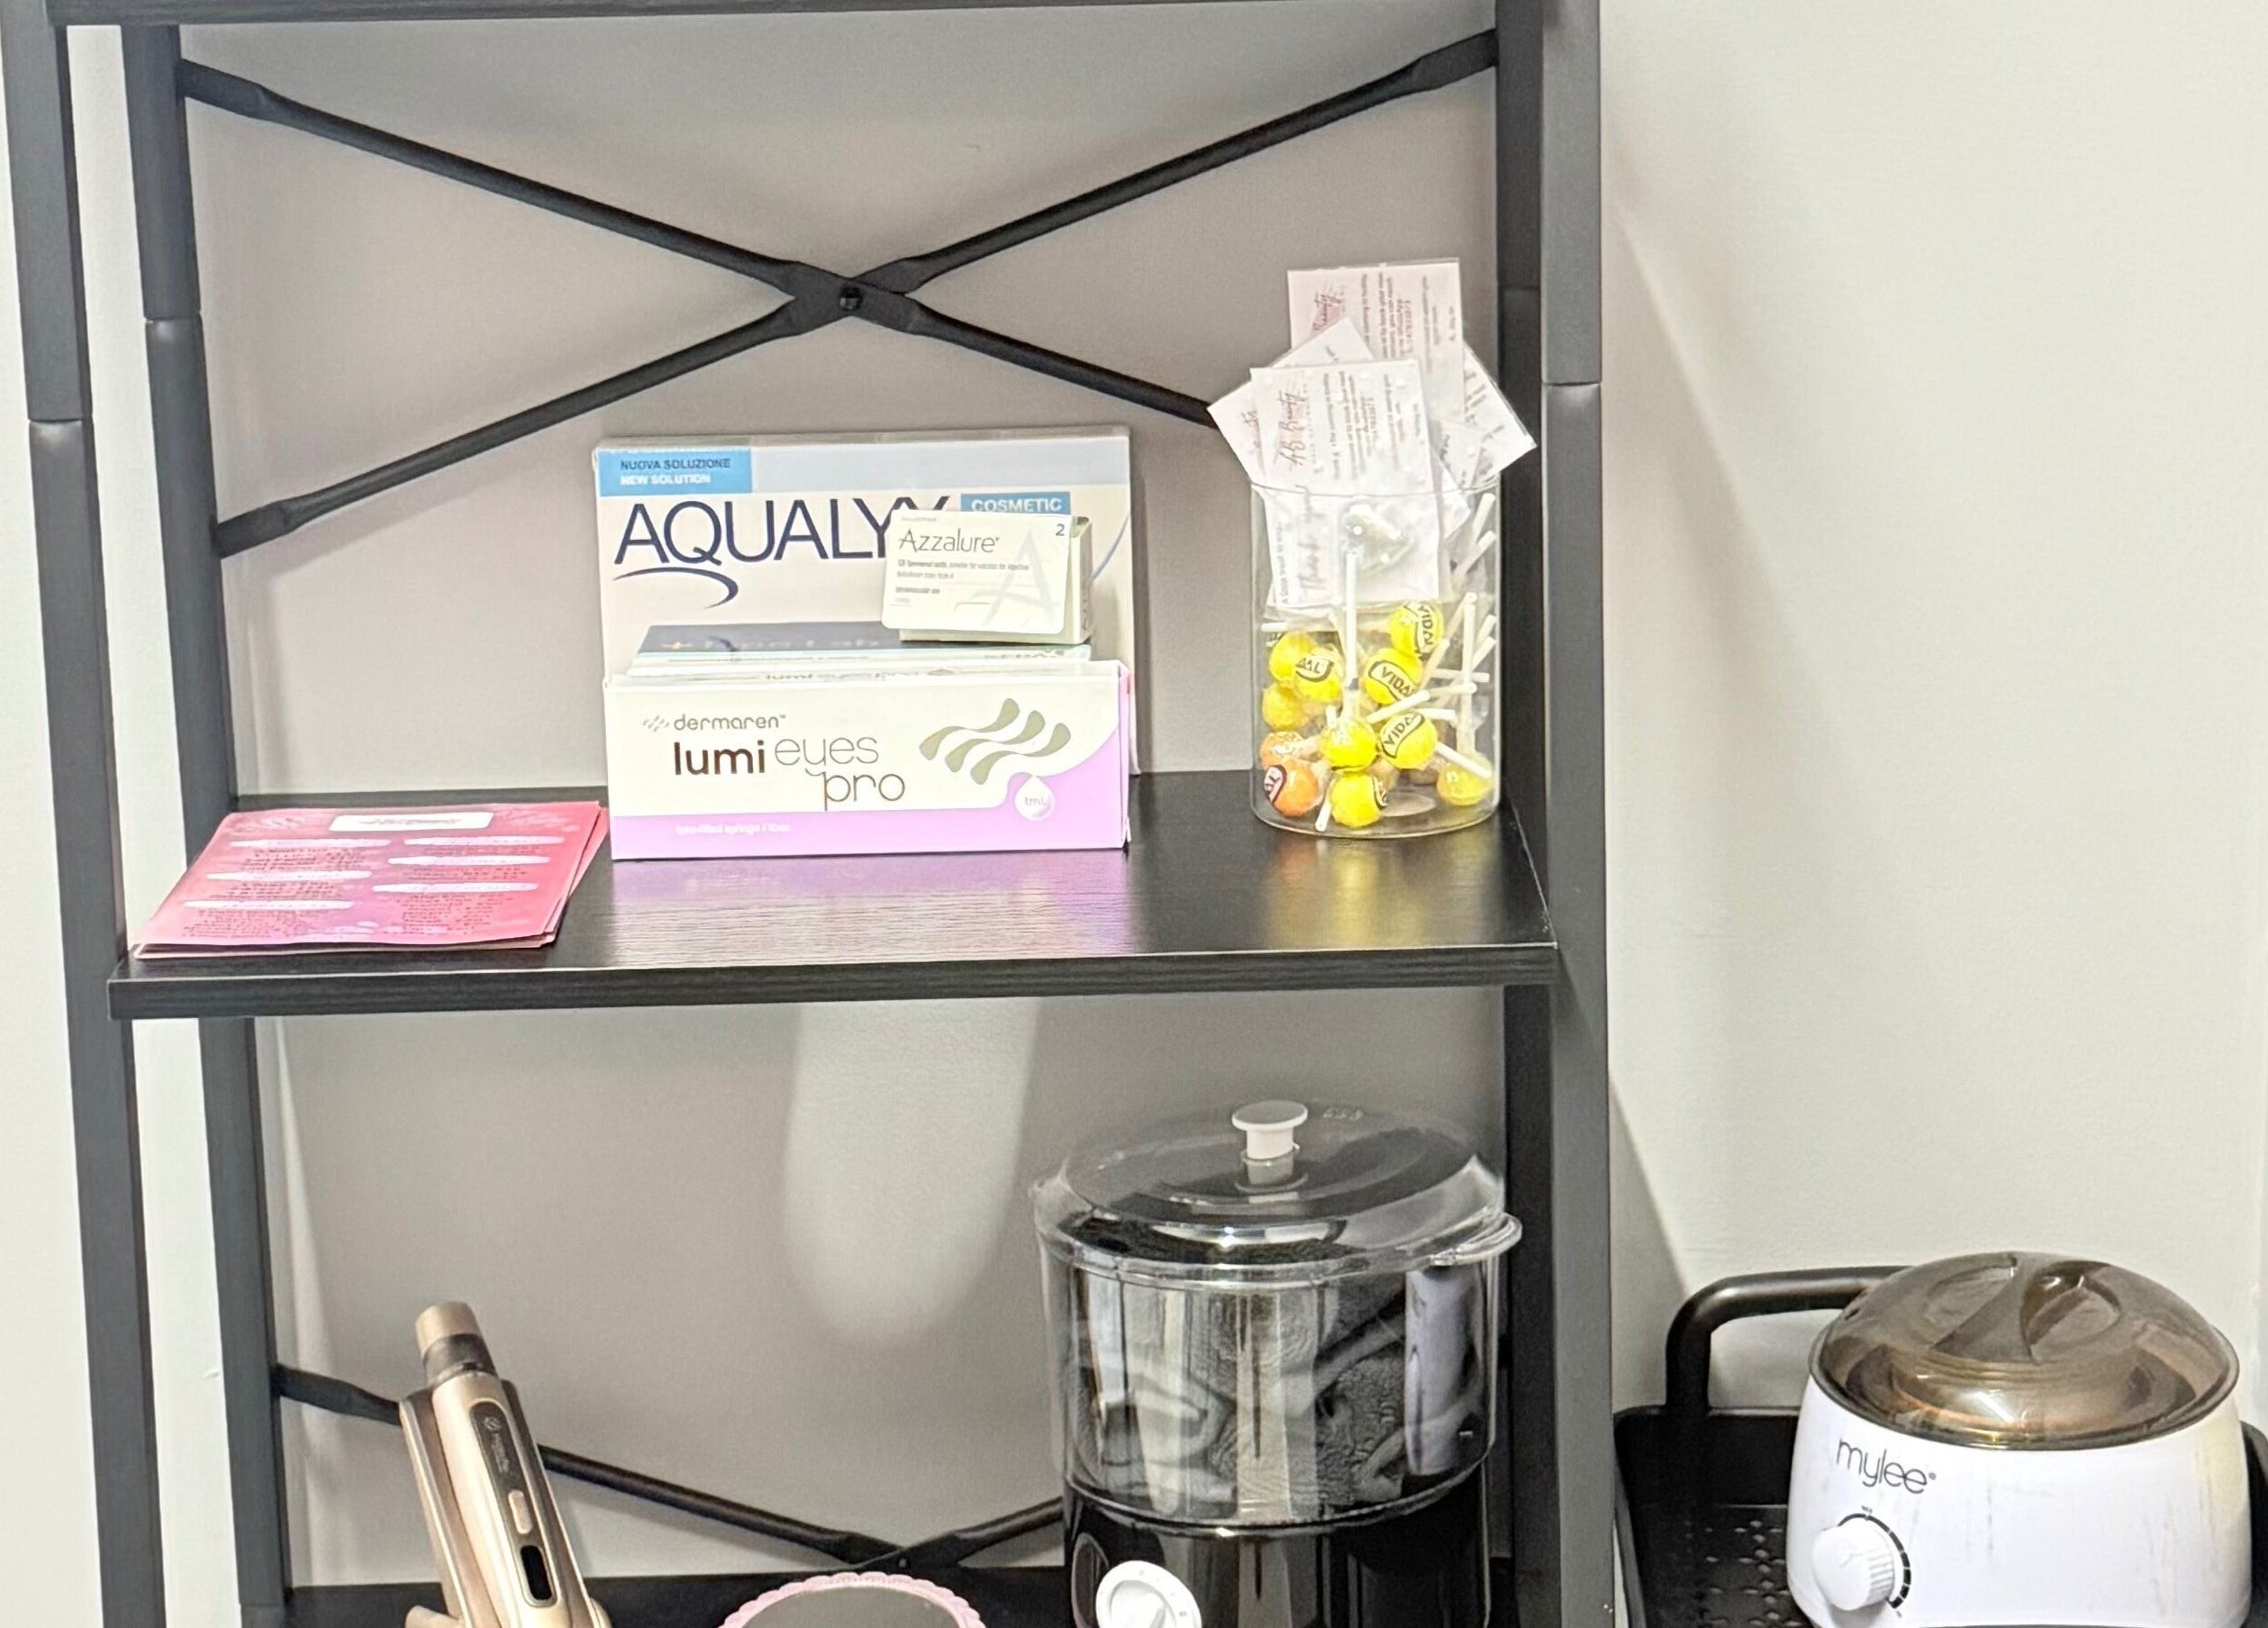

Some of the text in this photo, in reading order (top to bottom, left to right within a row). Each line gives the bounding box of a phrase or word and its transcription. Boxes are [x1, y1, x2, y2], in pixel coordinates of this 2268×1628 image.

[621, 458, 731, 470] NUOVA SOLUZIONE
[650, 473, 712, 485] SOLUTION
[971, 498, 1063, 513] COSMETIC
[614, 496, 949, 566] AQUALY
[898, 528, 996, 553] Azzalure
[1055, 523, 1066, 537] 2
[1381, 666, 1417, 697] VIDA
[674, 714, 779, 731] dermaren
[1383, 714, 1418, 746] VIDA
[674, 736, 879, 777] lumi eyes
[821, 770, 906, 812] pro
[1837, 1438, 1928, 1495] mylee
